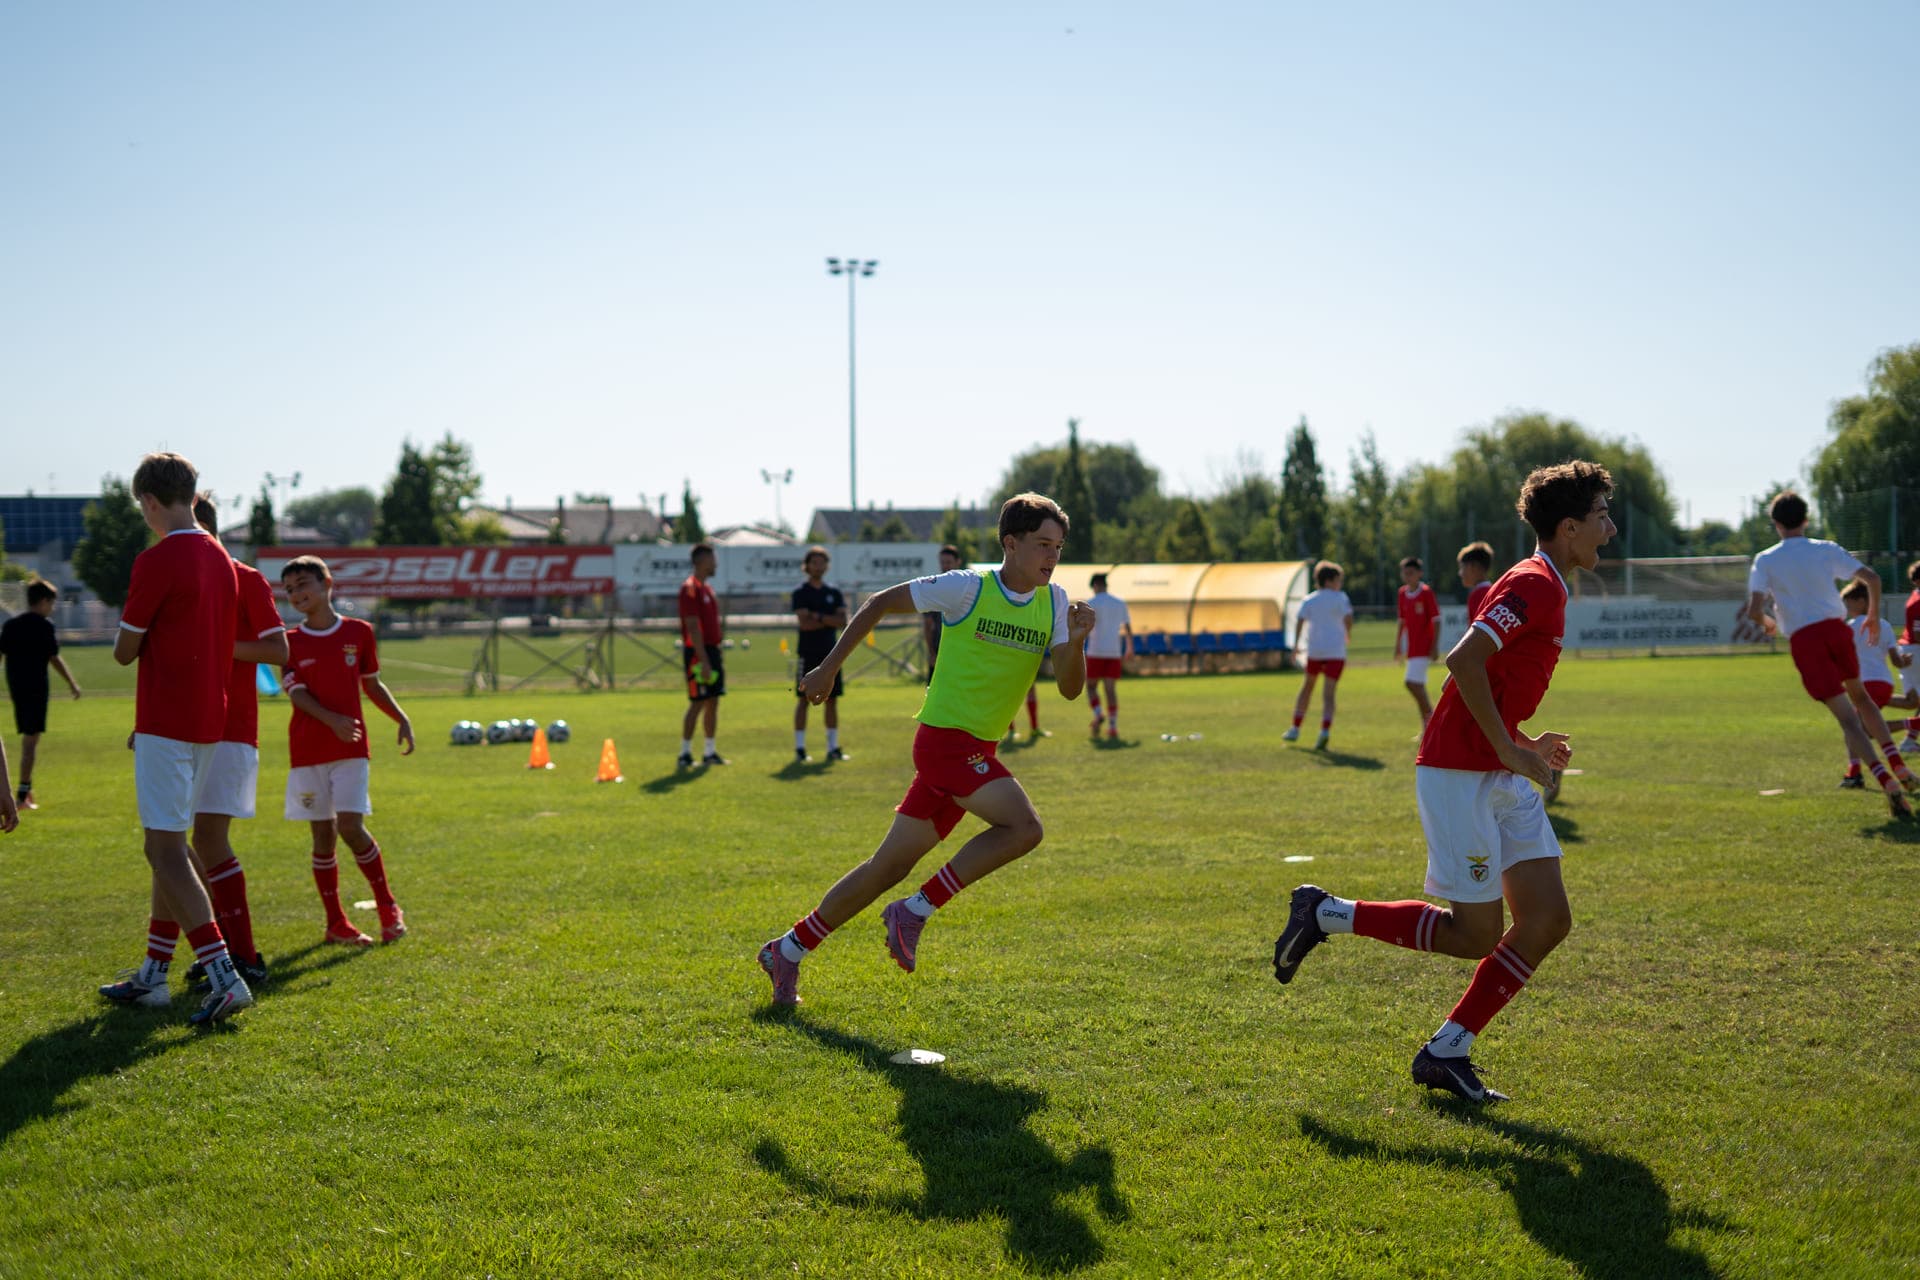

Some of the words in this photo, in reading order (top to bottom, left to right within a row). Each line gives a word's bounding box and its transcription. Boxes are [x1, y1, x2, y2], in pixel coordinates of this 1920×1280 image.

[389, 550, 569, 580] saller
[1486, 610, 1511, 634] BALL
[1494, 604, 1522, 628] FOOT
[976, 617, 1047, 647] DERBYSTAR
